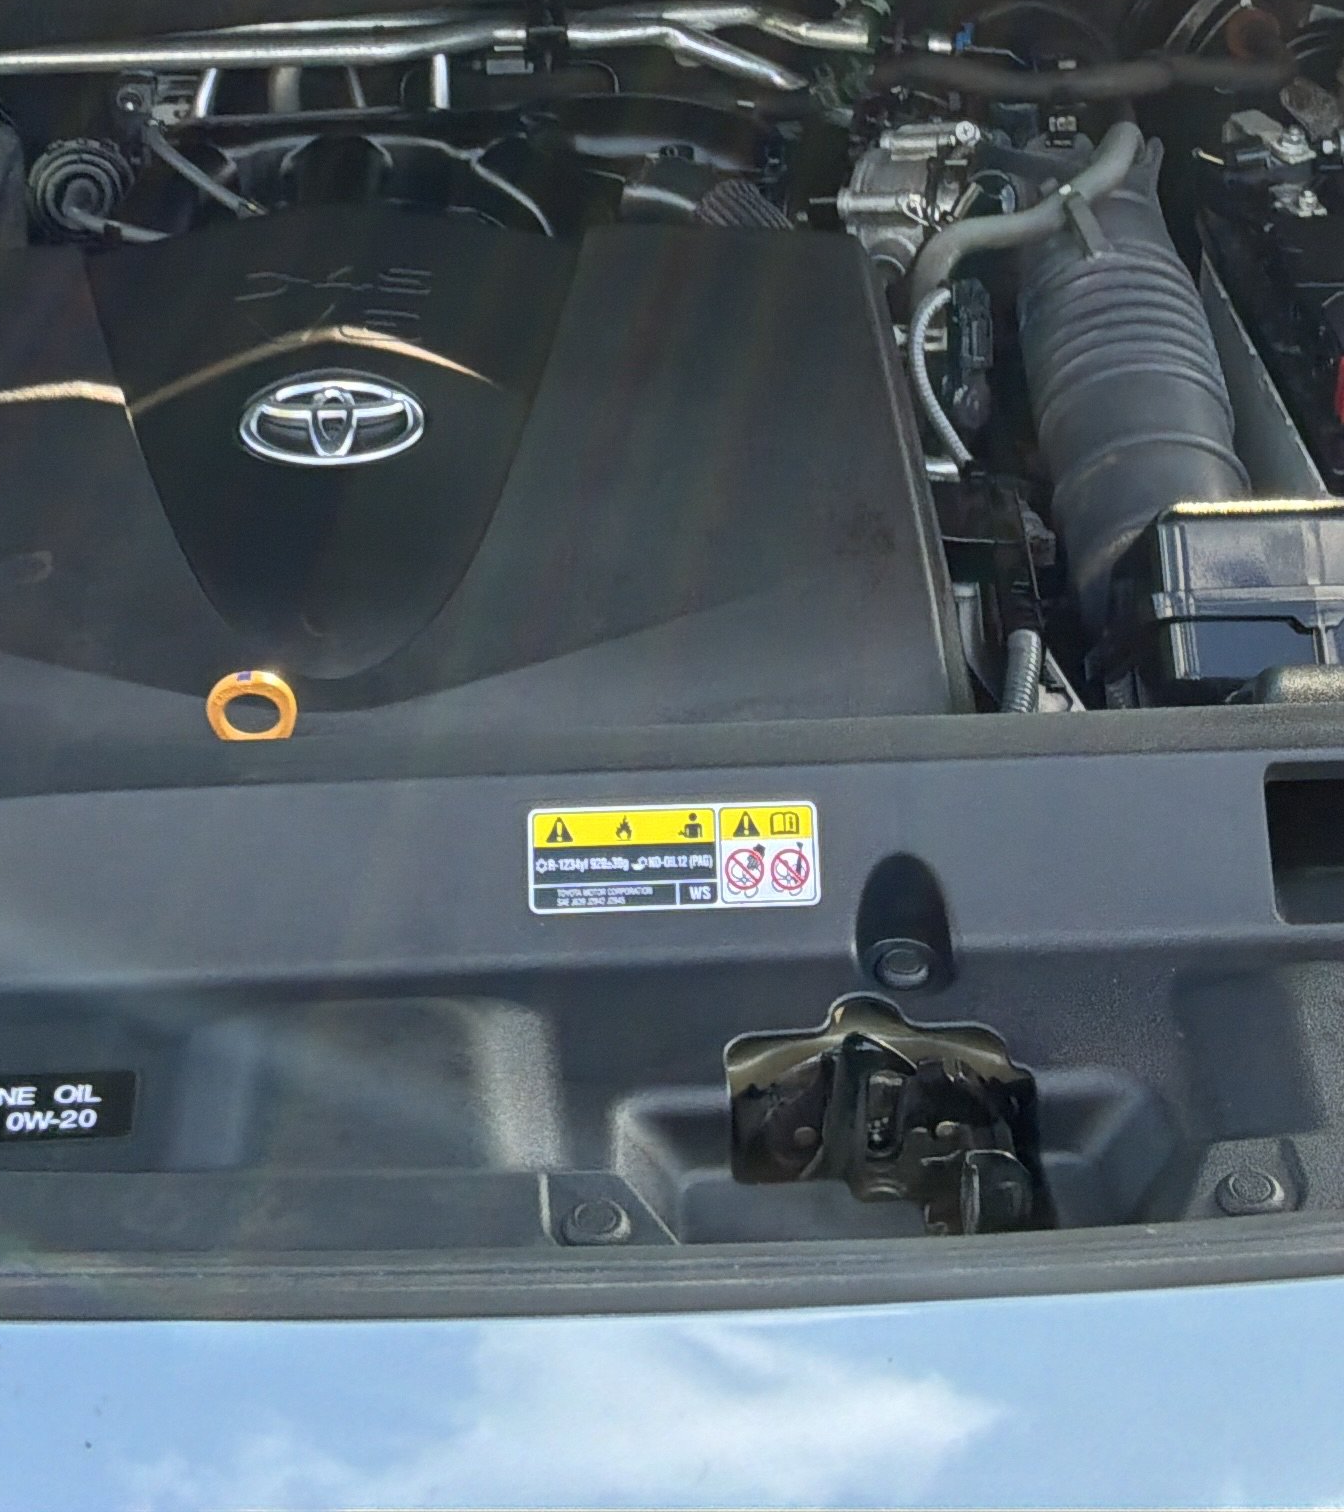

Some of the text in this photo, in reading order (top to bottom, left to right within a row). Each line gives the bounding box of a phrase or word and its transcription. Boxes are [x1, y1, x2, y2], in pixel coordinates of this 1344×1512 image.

[689, 854, 714, 870] (PAG)
[556, 886, 654, 898] TOYOTA MOTOR CORPORATION
[688, 885, 711, 901] WS
[53, 1083, 102, 1105] OIL
[5, 1108, 98, 1133] 0W-20
